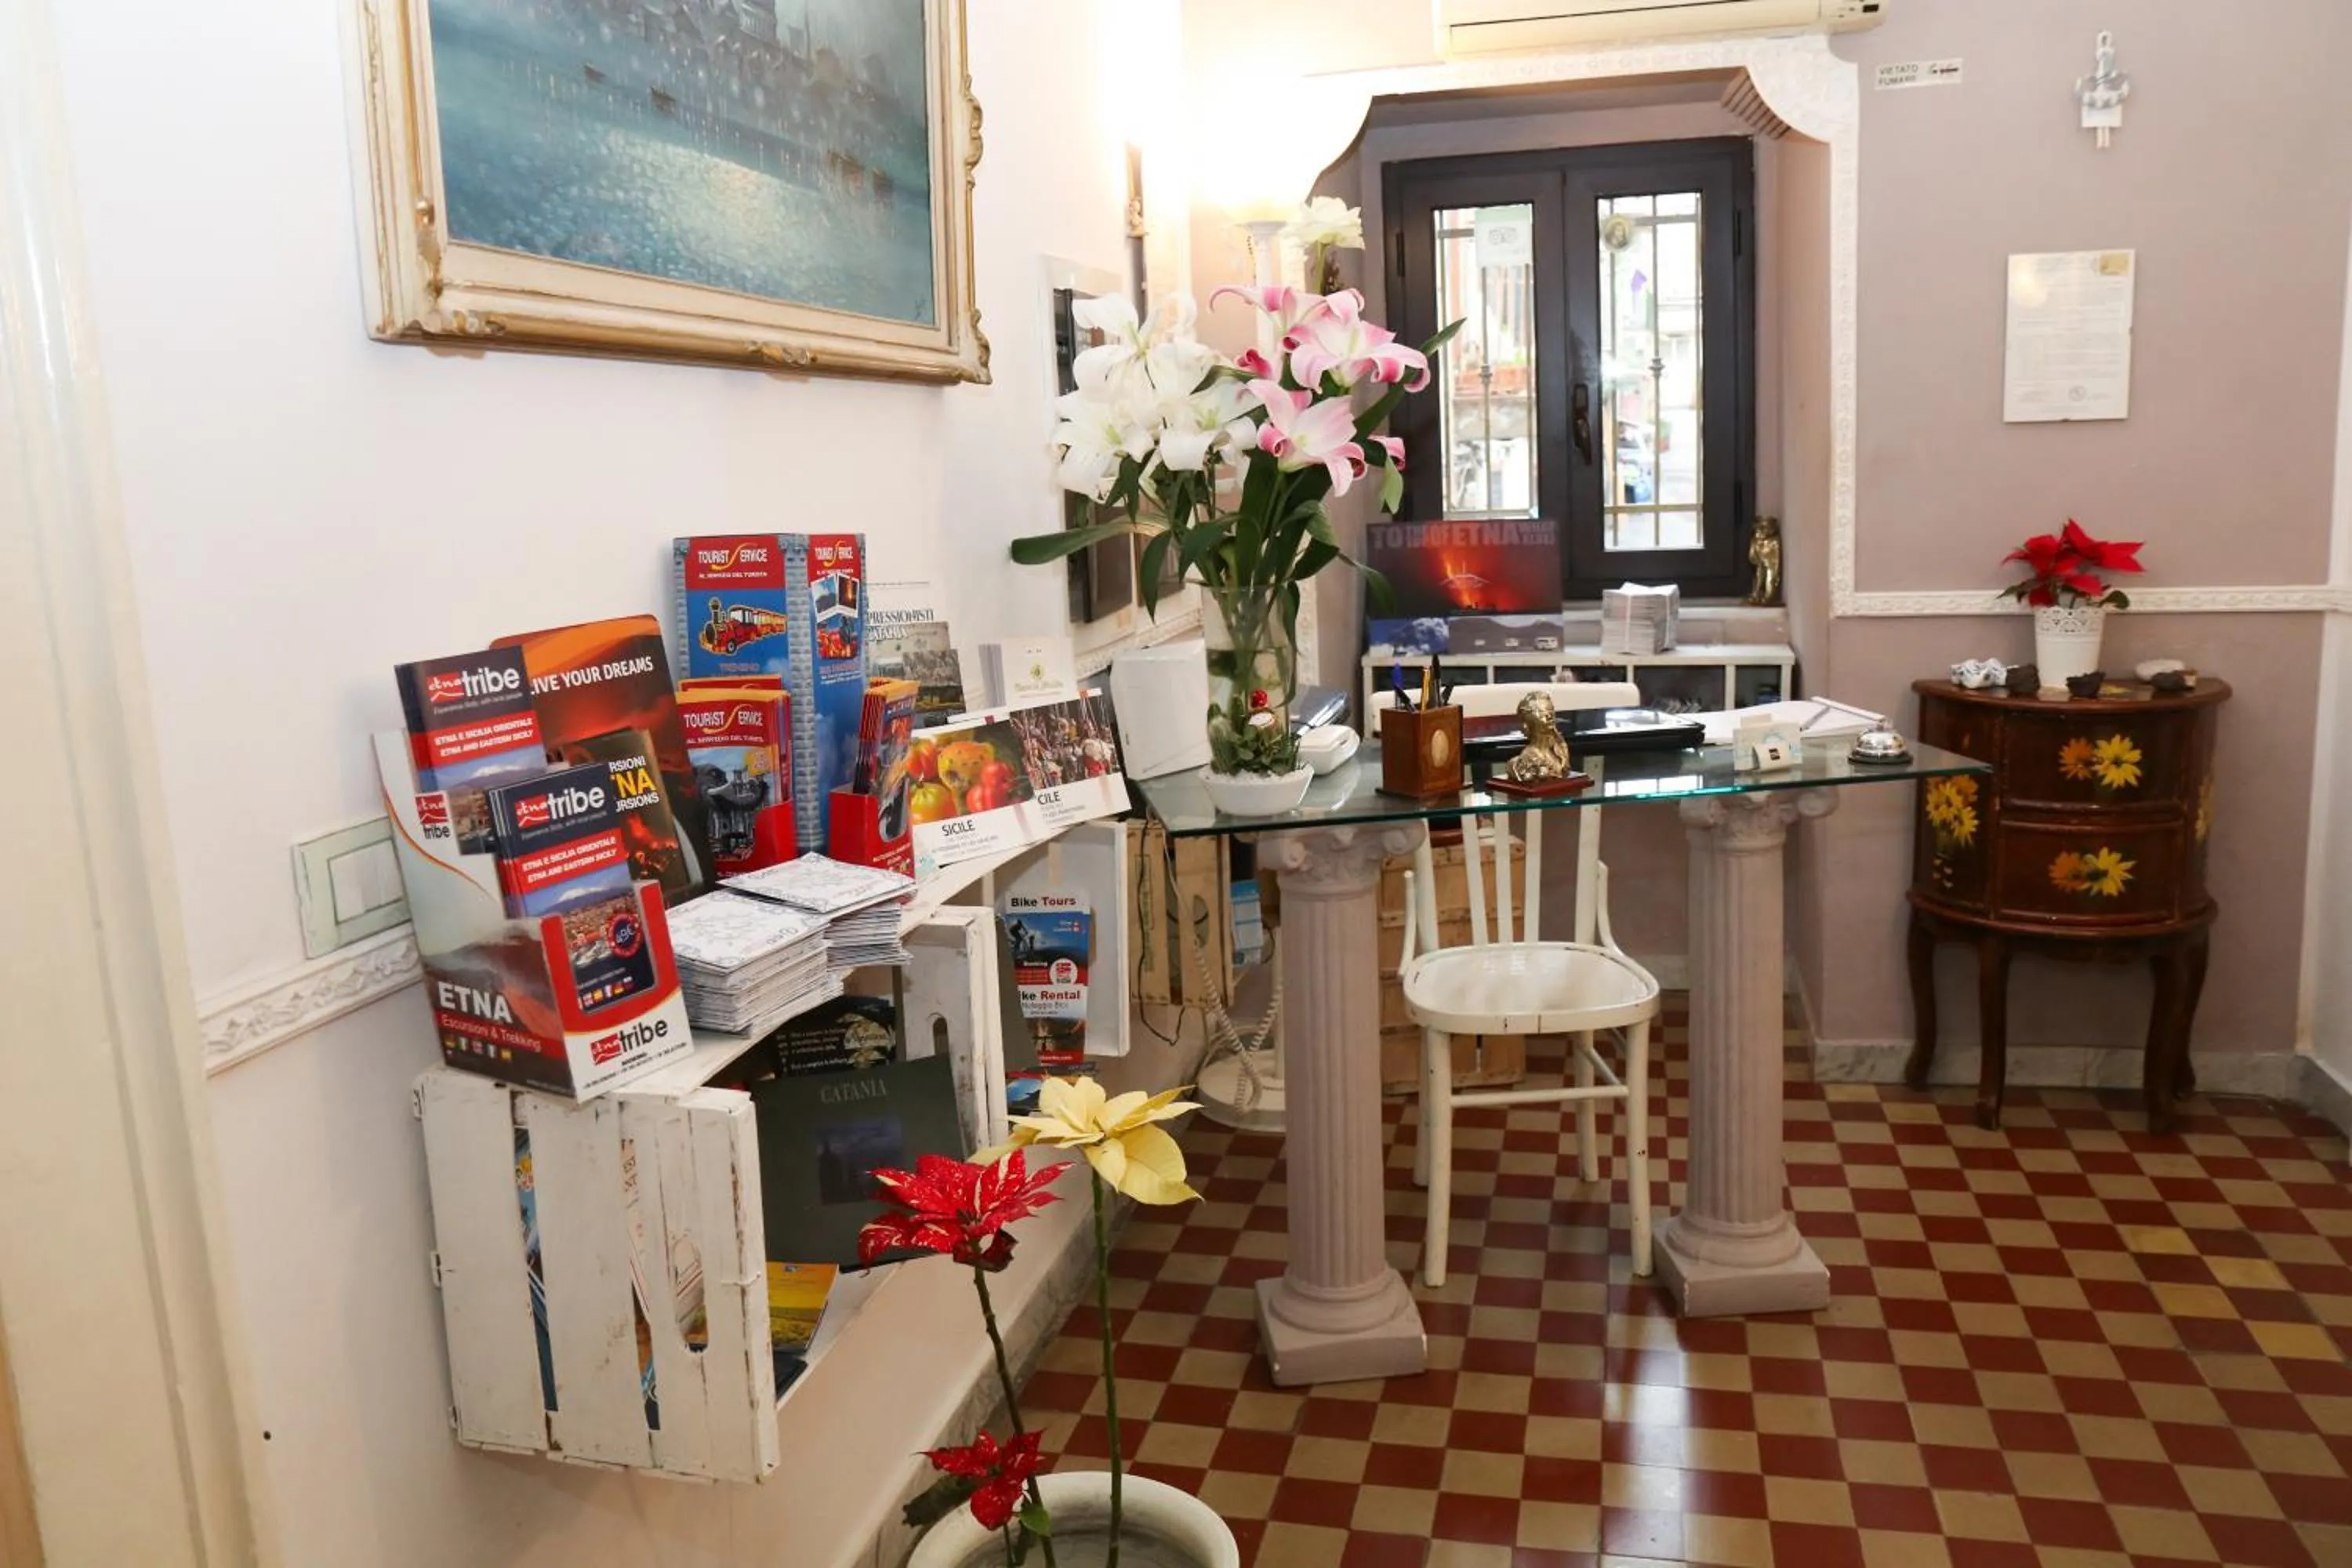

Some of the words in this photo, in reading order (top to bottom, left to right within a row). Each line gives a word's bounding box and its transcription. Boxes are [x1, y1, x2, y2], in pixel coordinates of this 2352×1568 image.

[699, 550, 729, 563] TOURIST
[461, 666, 521, 697] tribe
[531, 673, 561, 695] IVE
[561, 666, 602, 688] YOUR
[602, 656, 654, 680] DREAMS
[684, 711, 724, 728] TOURIST
[610, 768, 657, 798] NA
[547, 786, 605, 820] tribe
[942, 819, 975, 837] SICILE
[1011, 897, 1038, 907] Bike
[1041, 896, 1076, 906] Tours
[437, 981, 514, 1024] ETNA
[1040, 990, 1080, 1000] Rental
[619, 1020, 669, 1053] tribe
[820, 1079, 887, 1104] CATANIA
